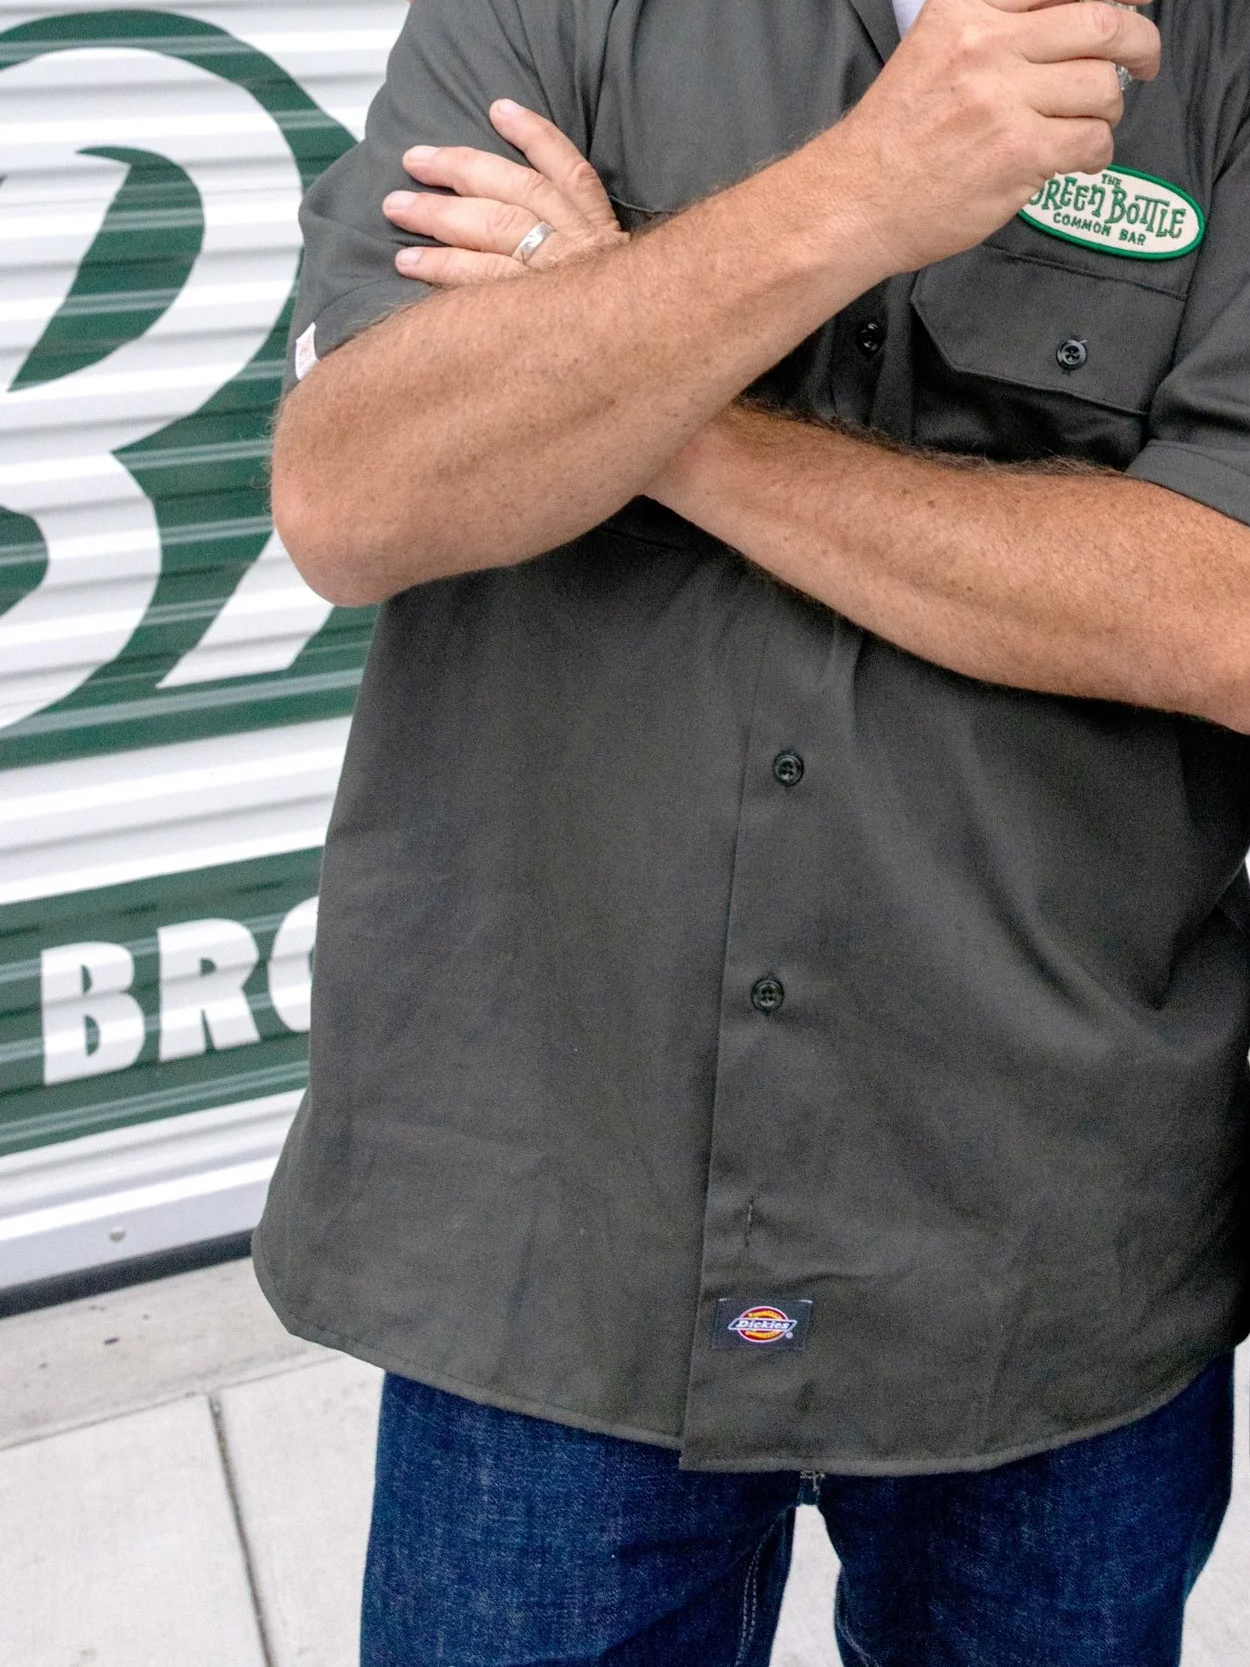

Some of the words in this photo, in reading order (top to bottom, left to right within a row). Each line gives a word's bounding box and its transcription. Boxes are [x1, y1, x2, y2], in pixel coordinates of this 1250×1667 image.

[1101, 173, 1122, 186] THE
[1053, 212, 1111, 237] COMMON
[1118, 229, 1147, 246] BAR
[735, 1319, 791, 1330] Dickies
